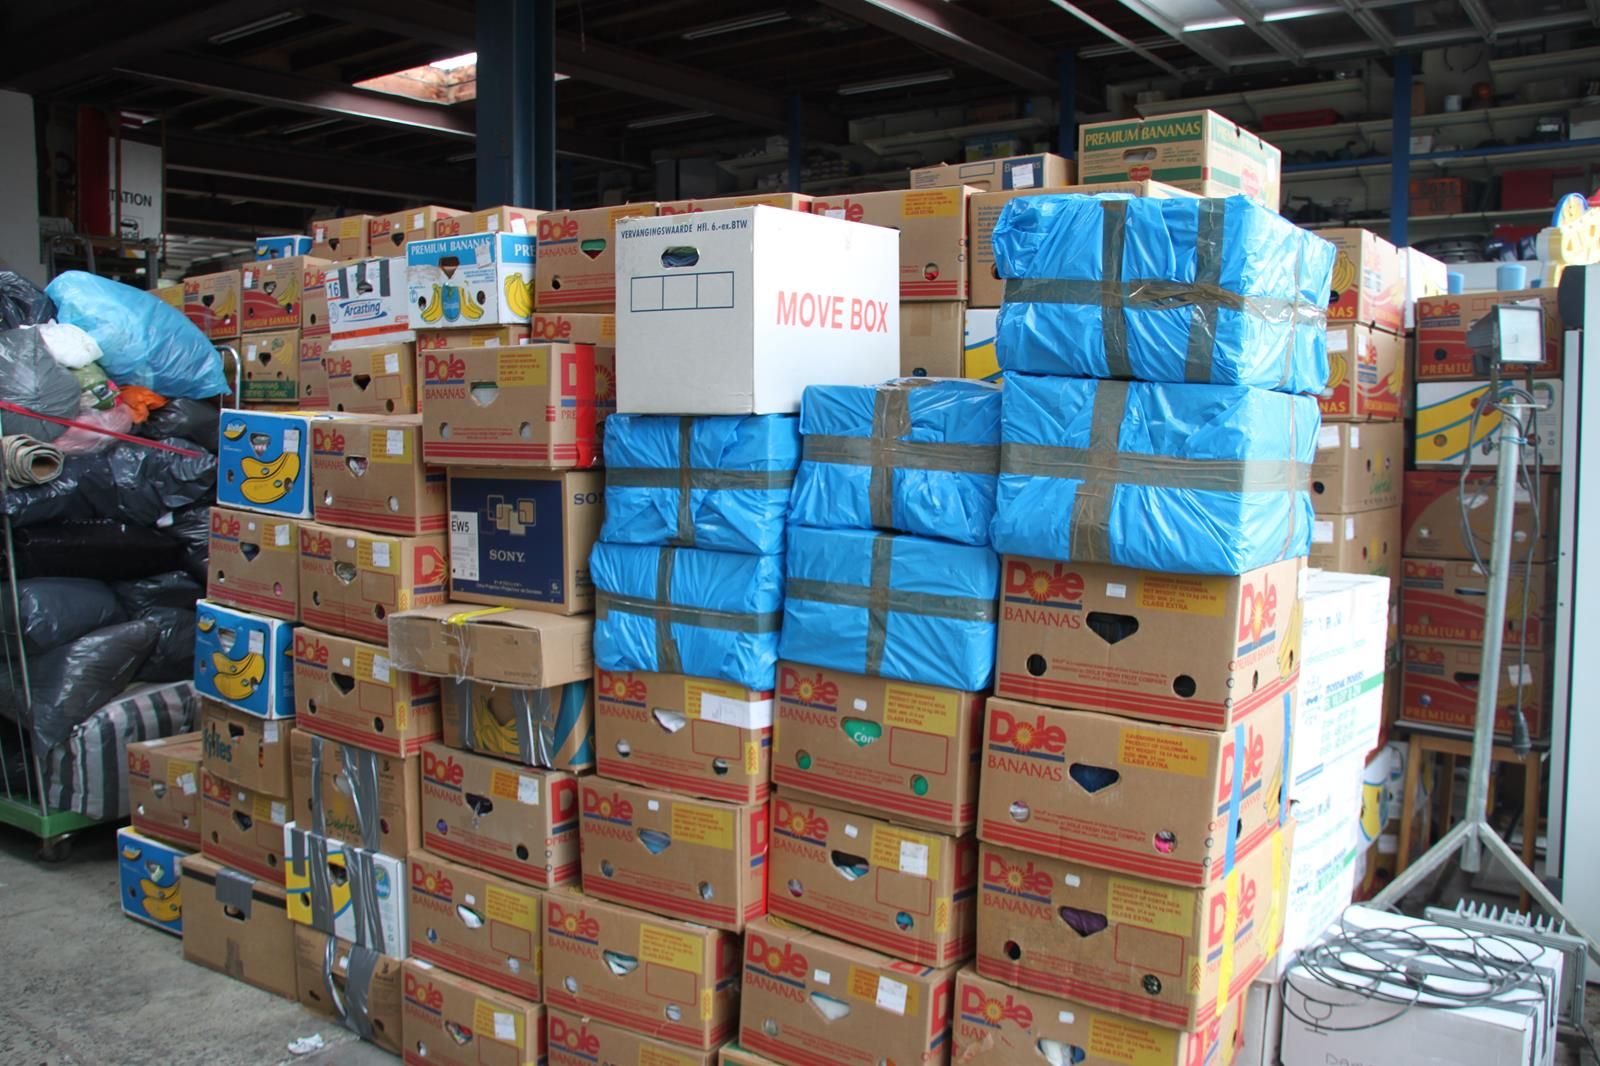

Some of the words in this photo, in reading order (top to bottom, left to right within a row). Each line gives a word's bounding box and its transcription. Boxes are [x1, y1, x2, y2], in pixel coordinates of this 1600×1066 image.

[1085, 129, 1139, 147] PREMIUM
[1141, 121, 1201, 139] BANANAS
[539, 216, 579, 240] Dole
[621, 224, 693, 239] VERVANGINGSWAARDE
[411, 241, 447, 256] PREMIUM
[449, 237, 490, 251] BANANAS
[329, 281, 340, 297] 16
[343, 301, 381, 317] Arcasting
[776, 291, 844, 329] MOVE
[850, 298, 889, 333] BOX
[533, 316, 573, 338] Dole
[327, 357, 352, 374] Dole
[424, 353, 466, 381] Dole
[425, 387, 466, 400] BANANAS
[313, 428, 345, 452] Dole
[574, 493, 604, 505] SO
[211, 512, 240, 538] Dole
[451, 521, 470, 533] EW5
[301, 527, 332, 555] Dole
[489, 549, 524, 563] SONY
[1005, 560, 1085, 601] Dole
[1004, 606, 1081, 629] BANANAS
[1238, 572, 1277, 642] Dole
[1405, 624, 1466, 639] PREMIUM
[295, 635, 328, 664] Dole
[598, 668, 648, 702] Dole
[780, 667, 839, 705] Dole
[599, 706, 649, 723] BANANAS
[779, 707, 838, 729] BANANAS
[989, 710, 1067, 754] Dole
[128, 751, 150, 775] Dole
[424, 751, 464, 786] Dole
[988, 754, 1063, 782] BANANAS
[203, 773, 231, 802] Dole
[424, 785, 464, 807] BANANAS
[583, 787, 634, 820] Dole
[584, 822, 635, 843] BANANAS
[774, 799, 829, 840] Dole
[774, 838, 827, 863] BANANAS
[412, 863, 454, 897] Dole
[983, 850, 1054, 896] Dole
[412, 894, 453, 917] BANANAS
[983, 894, 1051, 921] BANANAS
[548, 900, 600, 939] Dole
[549, 938, 599, 961] BANANAS
[747, 933, 808, 978] Dole
[404, 971, 444, 1008] Dole
[745, 973, 805, 1003] BANANAS
[962, 985, 1033, 1030] Dole
[551, 1016, 600, 1055] Dole
